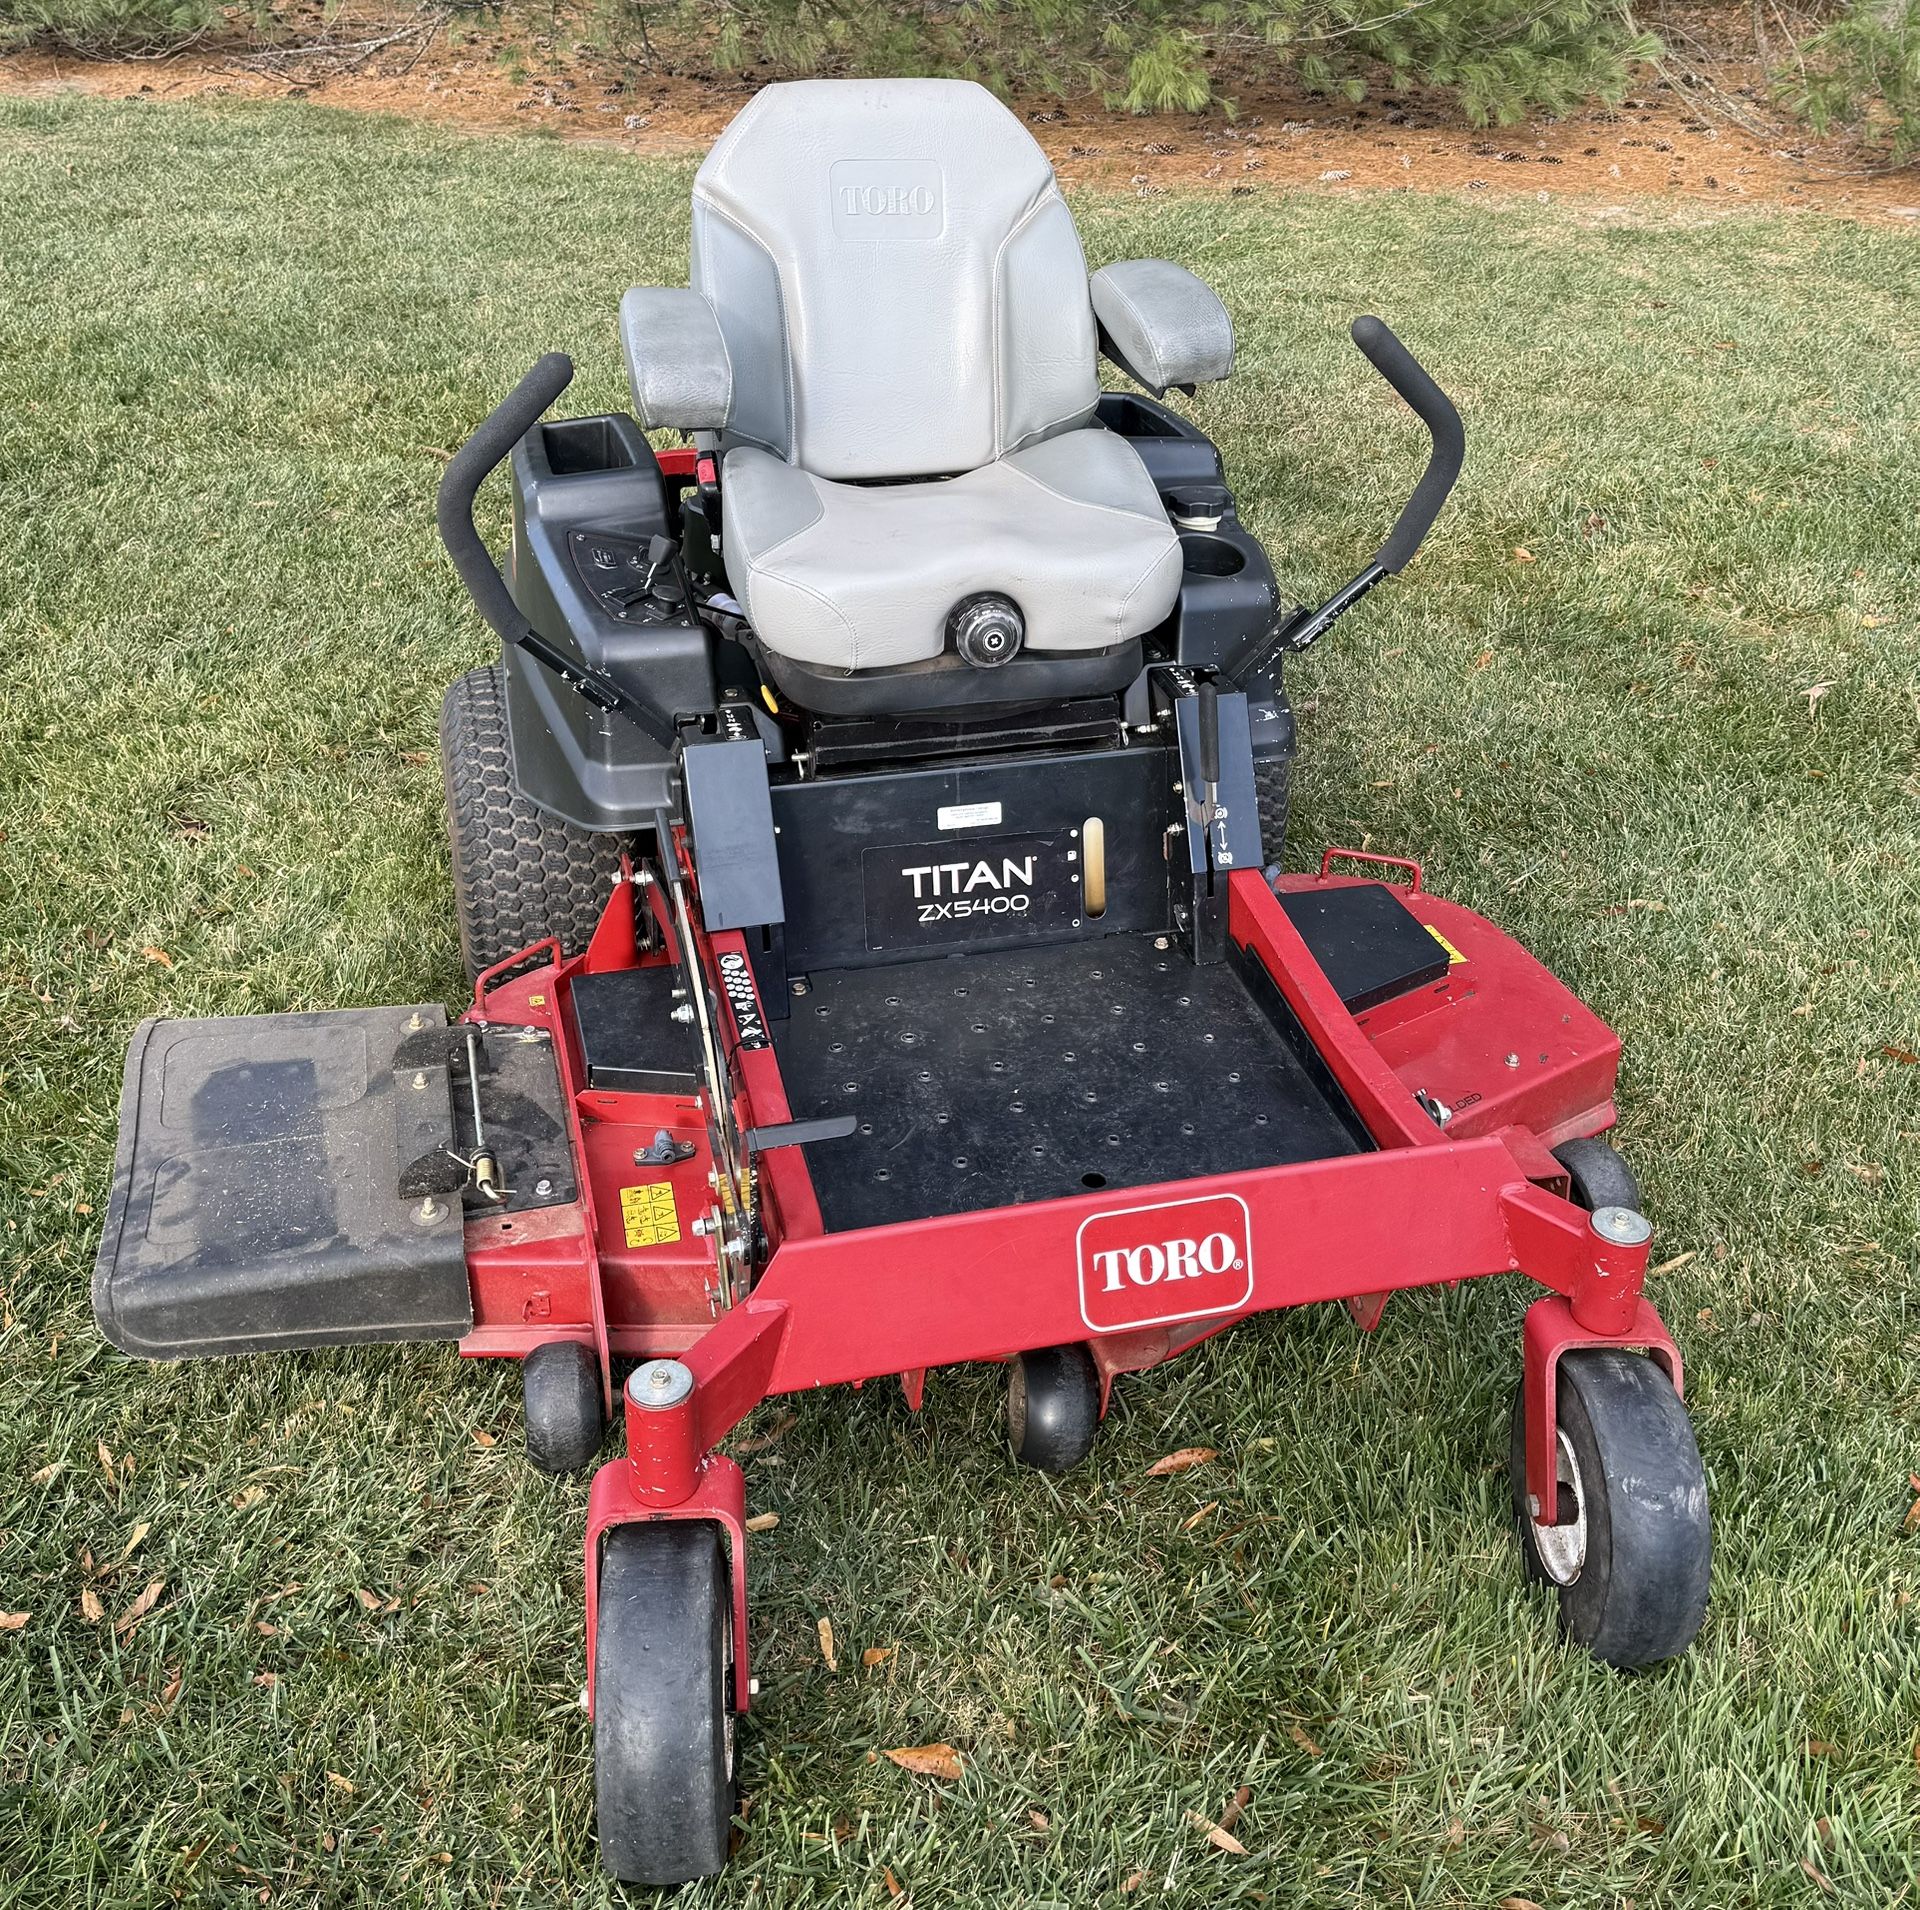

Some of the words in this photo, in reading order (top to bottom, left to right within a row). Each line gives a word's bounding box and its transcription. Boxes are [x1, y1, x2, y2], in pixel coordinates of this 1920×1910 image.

[840, 185, 935, 216] TORO
[901, 856, 1033, 898] TITAN
[917, 894, 1030, 923] ZX5400
